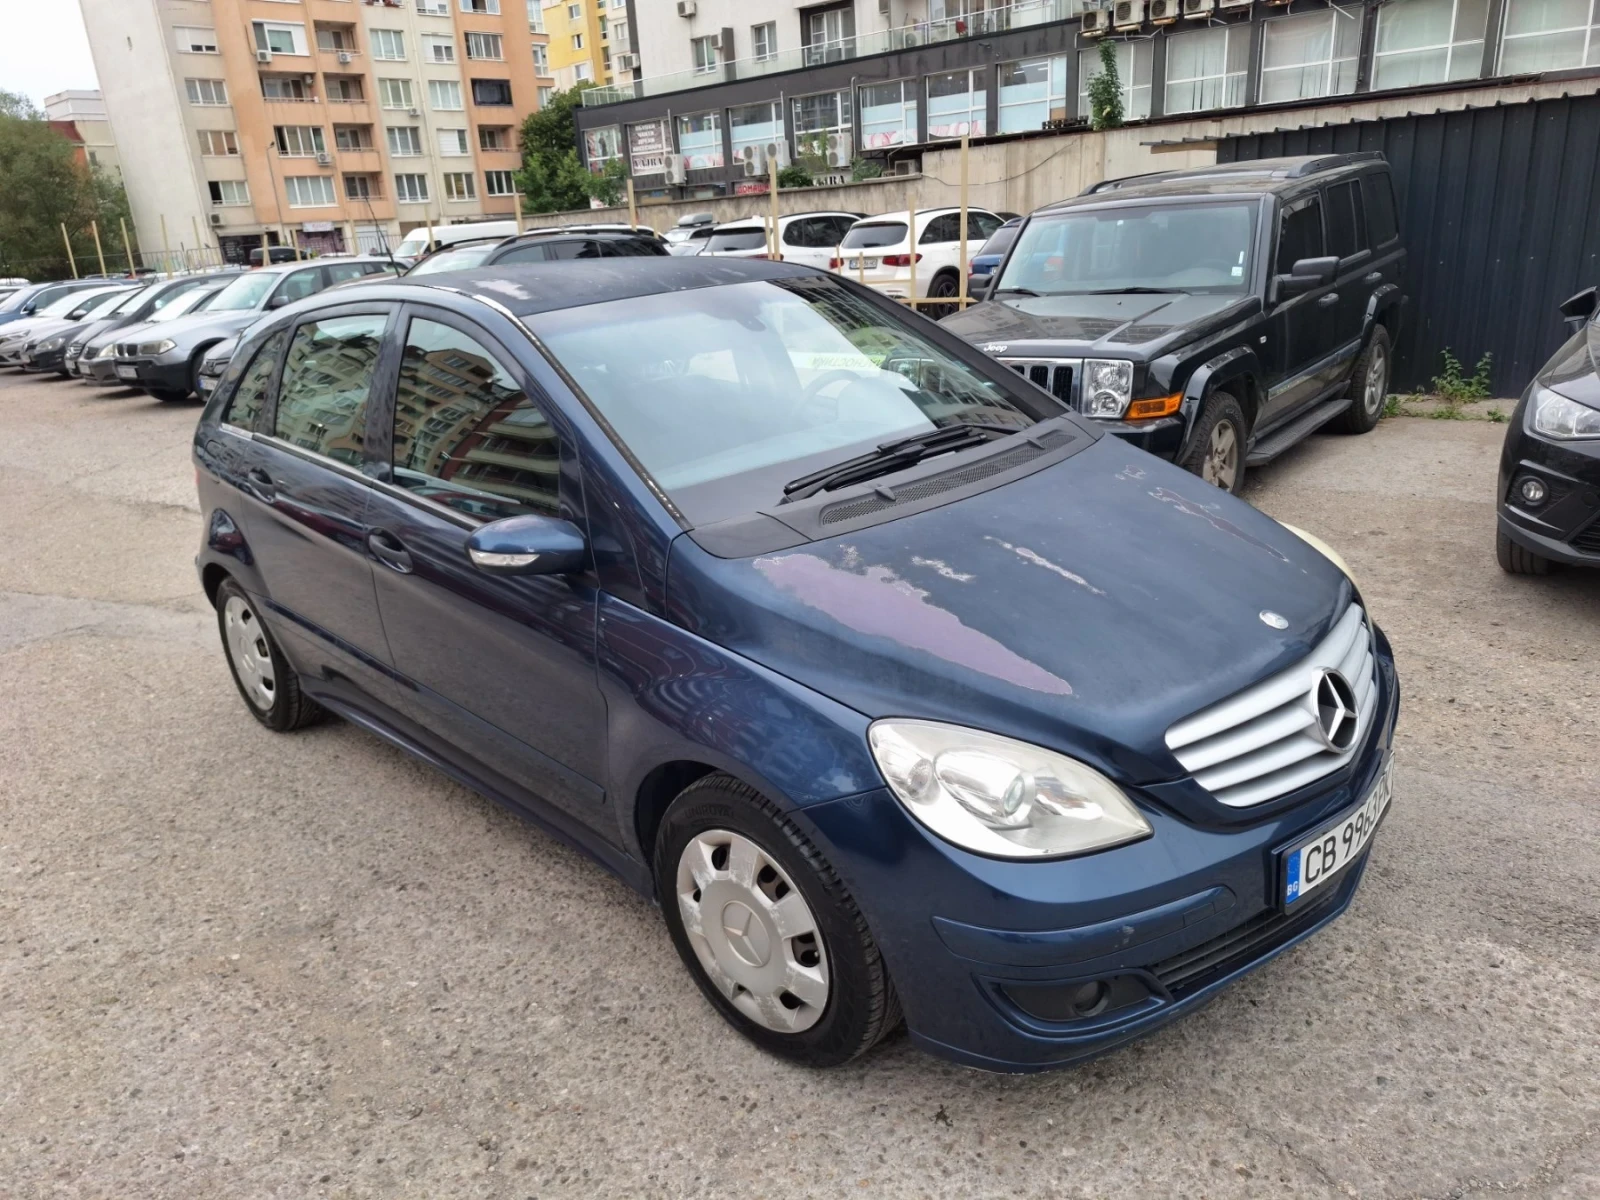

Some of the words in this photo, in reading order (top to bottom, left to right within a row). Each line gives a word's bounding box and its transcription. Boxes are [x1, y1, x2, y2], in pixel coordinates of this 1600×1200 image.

[983, 344, 1008, 353] Jeep
[1305, 835, 1336, 883] CB
[1286, 880, 1299, 896] BG
